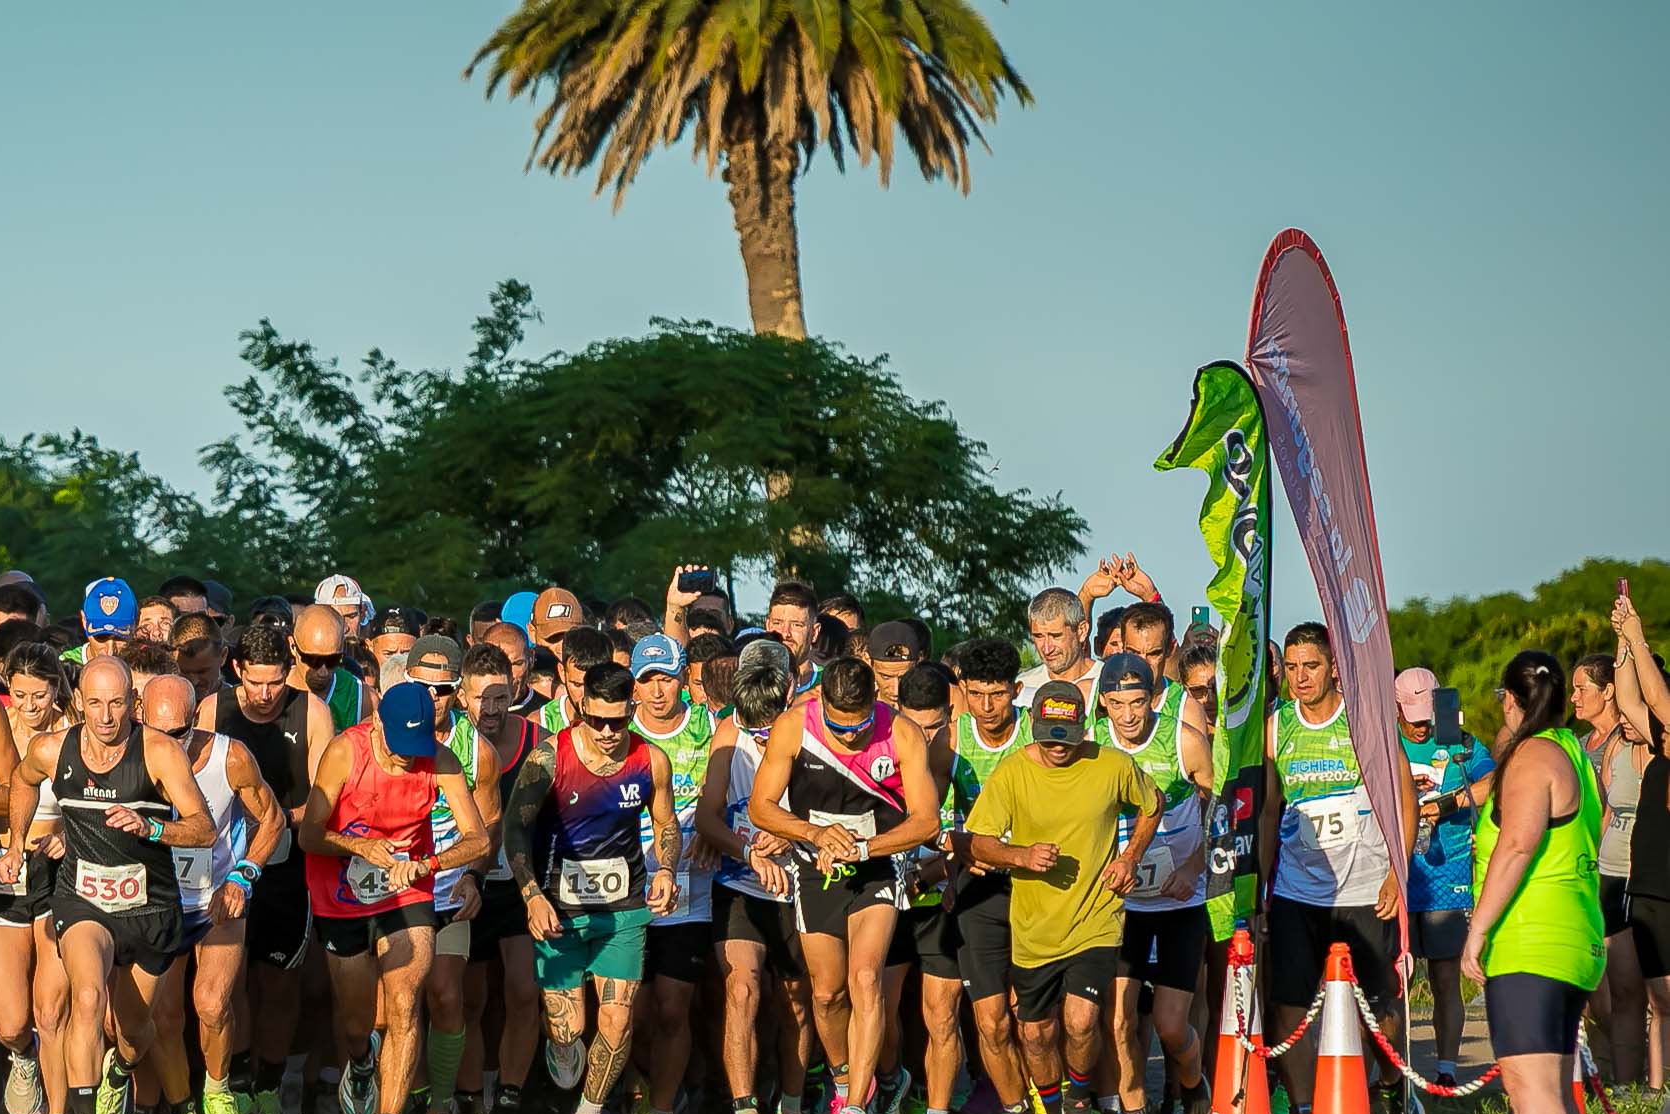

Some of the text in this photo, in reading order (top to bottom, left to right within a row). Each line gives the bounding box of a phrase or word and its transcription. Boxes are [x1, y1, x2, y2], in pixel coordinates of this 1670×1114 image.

[1289, 760, 1346, 774] FIGHIERA
[83, 785, 117, 799] ATENAS
[620, 783, 641, 800] VR
[618, 799, 642, 809] TEAM
[1311, 812, 1344, 839] 75
[178, 856, 195, 878] 7
[81, 875, 140, 901] 530
[567, 872, 622, 895] 130
